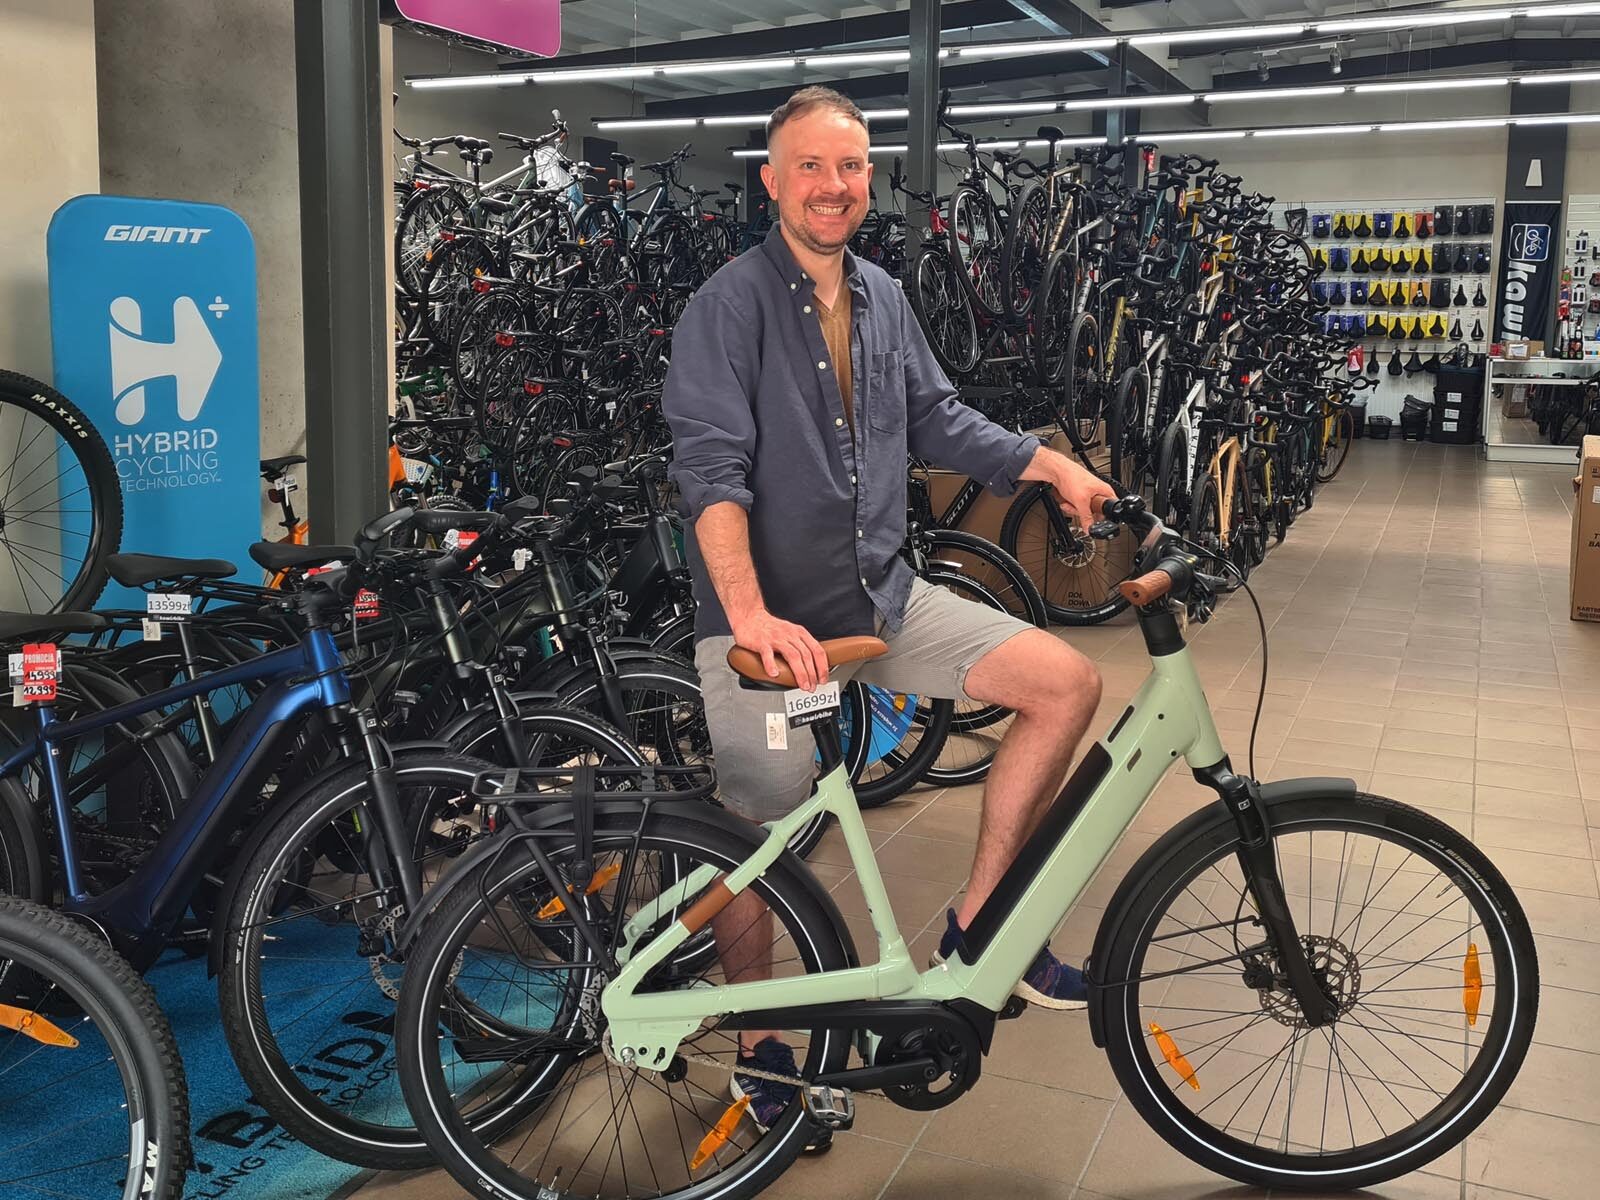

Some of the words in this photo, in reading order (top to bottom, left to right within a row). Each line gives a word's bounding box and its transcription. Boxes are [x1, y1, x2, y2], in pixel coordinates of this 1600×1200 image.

[103, 224, 212, 244] GIANT
[31, 393, 88, 438] MAXXIS
[114, 427, 219, 457] HYBRID
[115, 450, 219, 479] CYCLING
[945, 481, 975, 528] SCOTT
[788, 690, 837, 713] 16699zł
[140, 1137, 160, 1200] MA
